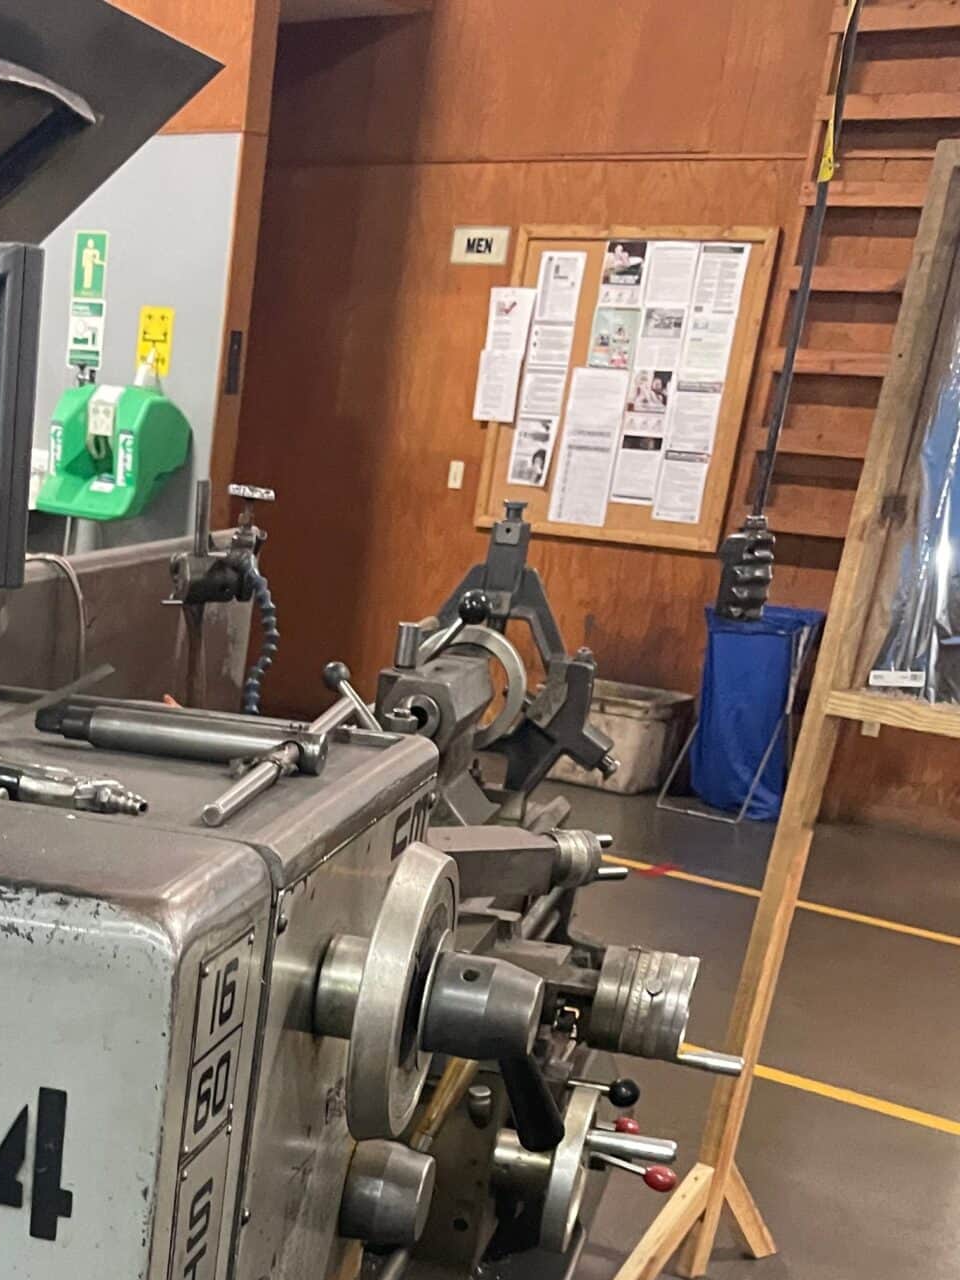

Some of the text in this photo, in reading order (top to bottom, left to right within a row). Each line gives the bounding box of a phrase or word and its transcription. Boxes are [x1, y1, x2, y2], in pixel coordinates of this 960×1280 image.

[465, 237, 493, 254] MEN
[208, 956, 240, 1036] 16
[193, 1050, 231, 1136] 60
